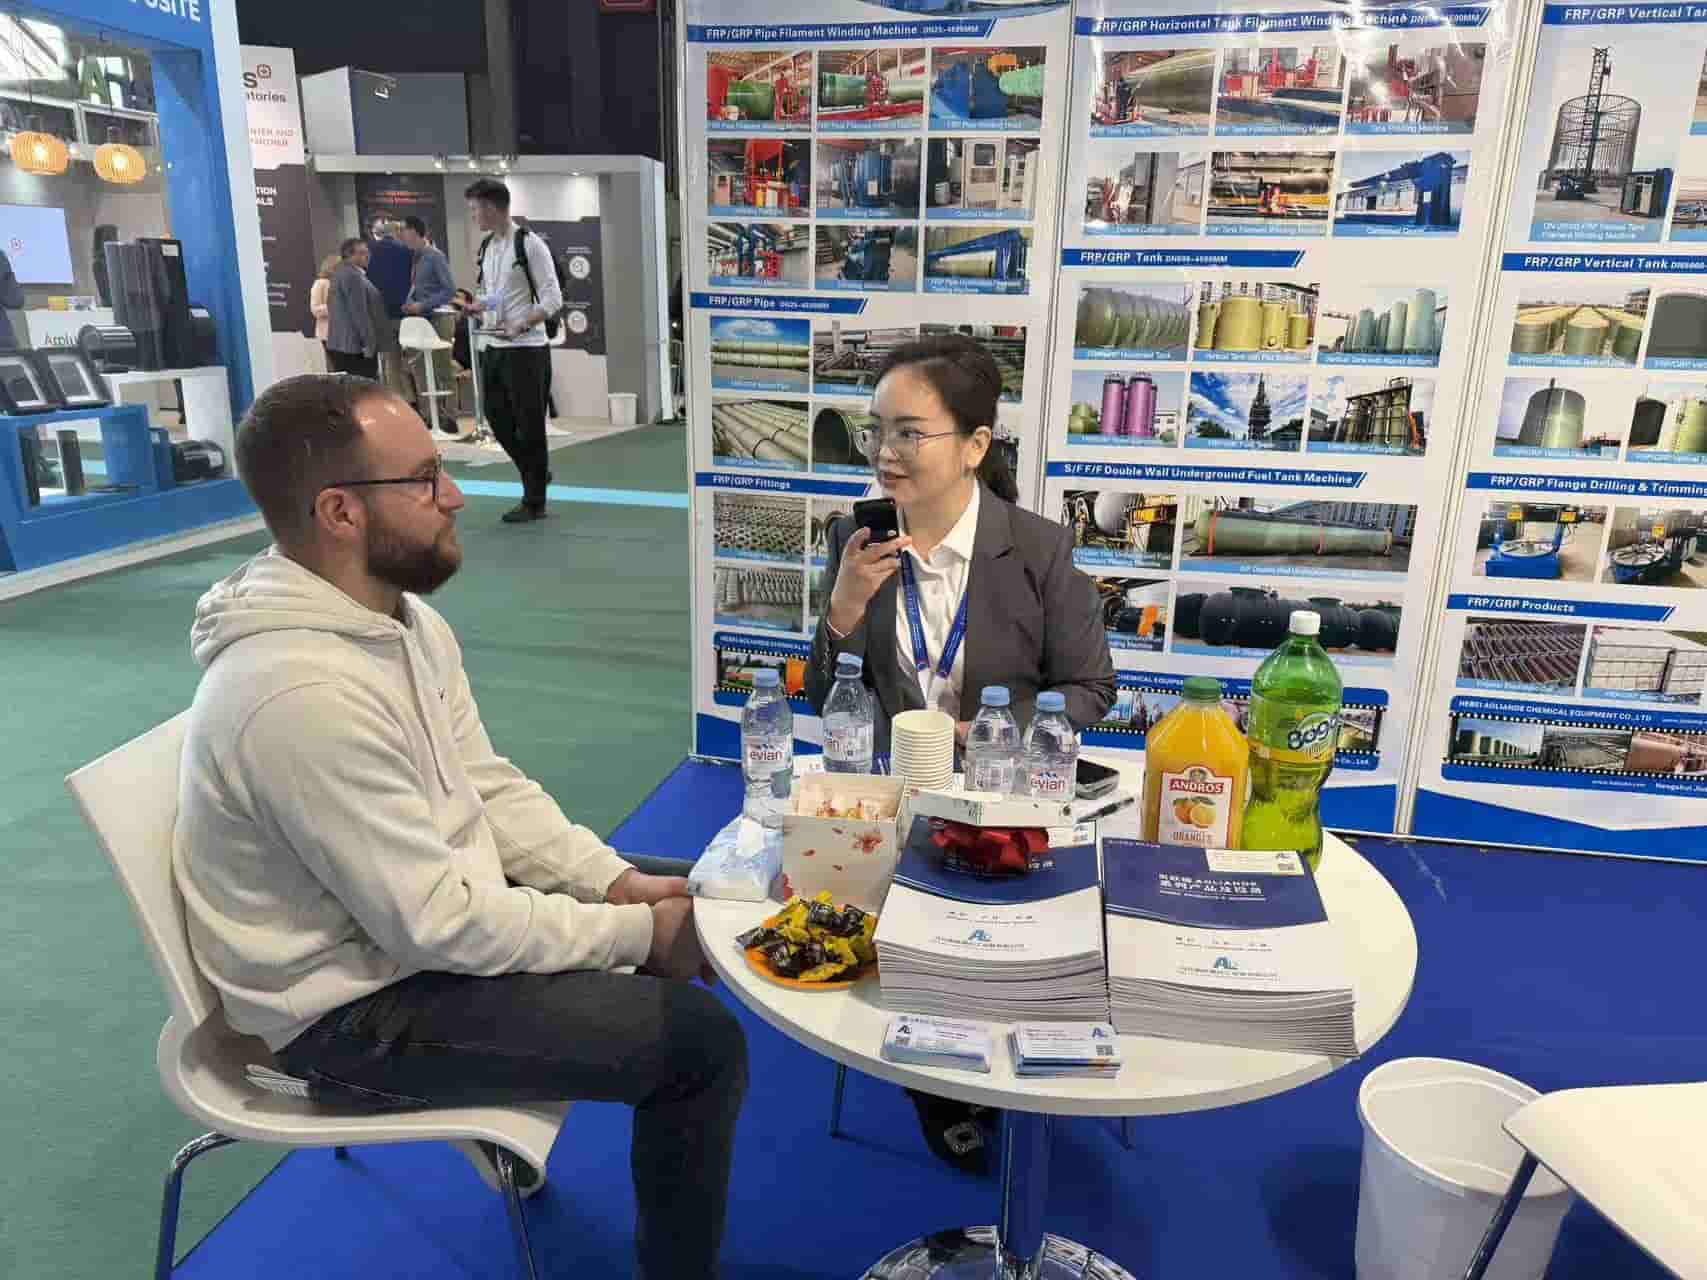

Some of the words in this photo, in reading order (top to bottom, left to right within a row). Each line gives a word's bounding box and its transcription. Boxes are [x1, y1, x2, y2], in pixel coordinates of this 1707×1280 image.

[1564, 7, 1625, 20] FRP/GRP
[1629, 5, 1681, 18] Vertical
[1092, 20, 1147, 33] FRP/GRP
[1150, 18, 1211, 31] Horizontal
[1214, 17, 1241, 30] Tank
[1245, 16, 1297, 29] Filament
[1300, 14, 1352, 27] Windig
[705, 27, 753, 40] FRP/GRP
[755, 28, 777, 40] Pipe
[779, 26, 825, 39] Filament
[827, 25, 870, 39] Winding
[872, 25, 917, 38] Machine
[1079, 251, 1131, 263] FRP/GRP
[1136, 252, 1163, 263] Tank
[1524, 255, 1582, 268] FRP/GRP
[1584, 256, 1634, 269] Vertical
[1637, 257, 1668, 269] Tank
[708, 295, 752, 307] FRP/GRP
[753, 296, 776, 309] Pipe
[712, 474, 753, 486] FRP/GRP
[755, 477, 791, 490] Fittings
[1104, 464, 1143, 477] Double
[1145, 466, 1169, 478] Wall
[1171, 466, 1245, 482] Underground
[1247, 470, 1272, 481] Fuel
[1275, 470, 1300, 482] Tank
[1303, 472, 1354, 485] Machine
[1489, 474, 1544, 488] FRP/GRP
[1546, 477, 1587, 491] Flange
[1590, 479, 1635, 493] Drilling
[1637, 482, 1648, 492] &
[1467, 596, 1520, 609] FRP/GRP
[1521, 599, 1576, 613] Products
[1569, 708, 1617, 720] EQUPMENT
[749, 748, 783, 761] evian
[1030, 777, 1066, 793] evian
[1170, 779, 1224, 793] ANDROS
